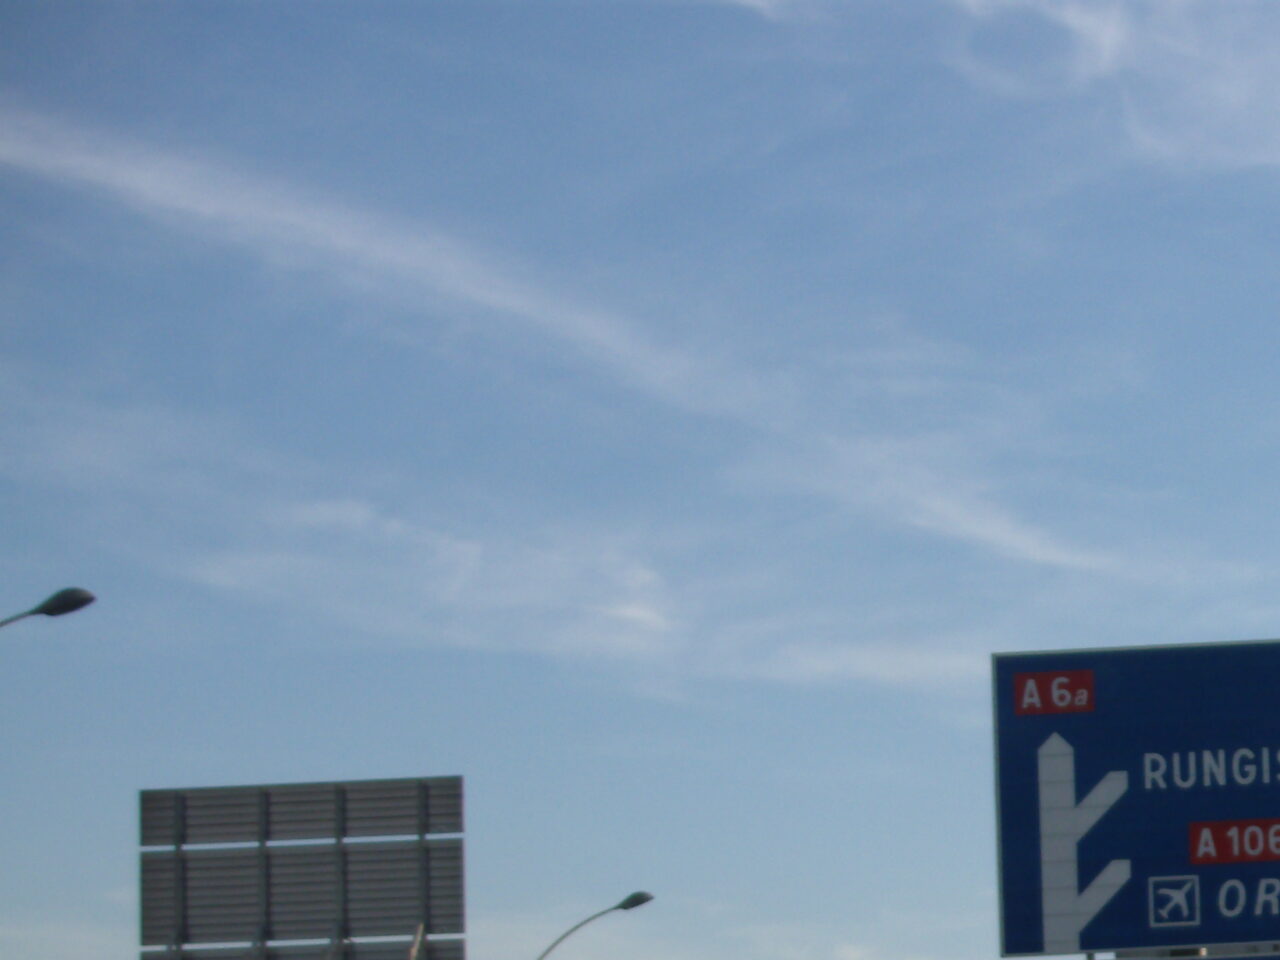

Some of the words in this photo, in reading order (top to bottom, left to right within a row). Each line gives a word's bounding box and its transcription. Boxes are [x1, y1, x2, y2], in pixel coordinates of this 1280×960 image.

[1021, 678, 1041, 708] A
[1051, 676, 1088, 707] 6a
[1197, 827, 1217, 857] A
